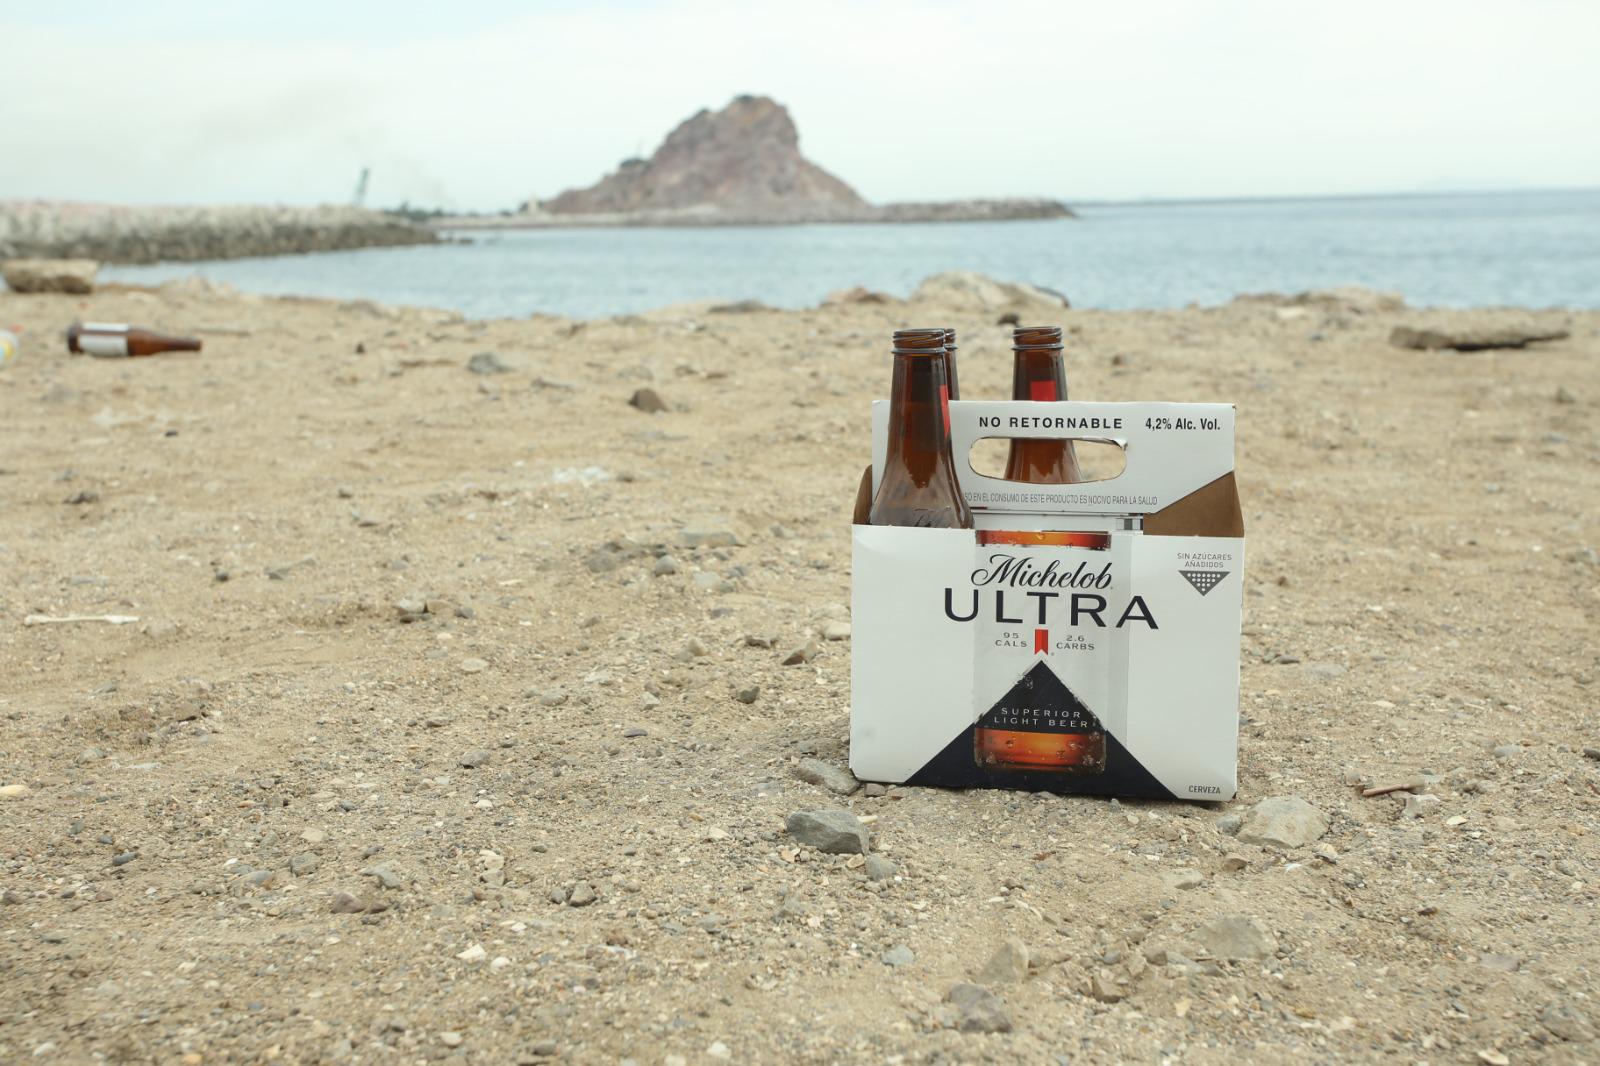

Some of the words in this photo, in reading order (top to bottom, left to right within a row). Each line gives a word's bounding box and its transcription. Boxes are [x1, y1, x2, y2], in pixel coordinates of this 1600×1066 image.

[979, 416, 1001, 429] NO
[1009, 416, 1123, 430] RETORNABLE
[1145, 417, 1172, 431] 4,2%
[1175, 417, 1197, 431] Alc.
[1200, 418, 1221, 431] Vol.
[990, 492, 1020, 503] CONSUMO
[1030, 493, 1045, 504] ESTE
[1045, 494, 1079, 504] PRODUCTO
[1079, 495, 1087, 505] ES
[1088, 495, 1111, 505] NOCIVO
[1112, 495, 1128, 505] PARA
[1129, 496, 1137, 506] LA
[1138, 496, 1158, 506] SALUD
[1177, 552, 1190, 560] SIN
[1192, 552, 1232, 561] AZÚCARES
[1184, 560, 1224, 568] AÑADIDOS
[970, 553, 1113, 590] Michelob
[944, 587, 1159, 630] ULTRA
[995, 639, 1028, 648] CALS
[1066, 634, 1085, 642] 2.6
[1056, 642, 1095, 651] CARBS
[1001, 707, 1080, 718] SUPERIOR
[994, 717, 1038, 726] LIGHT
[1048, 719, 1088, 728] BEER
[1188, 785, 1221, 794] CERVEZA
